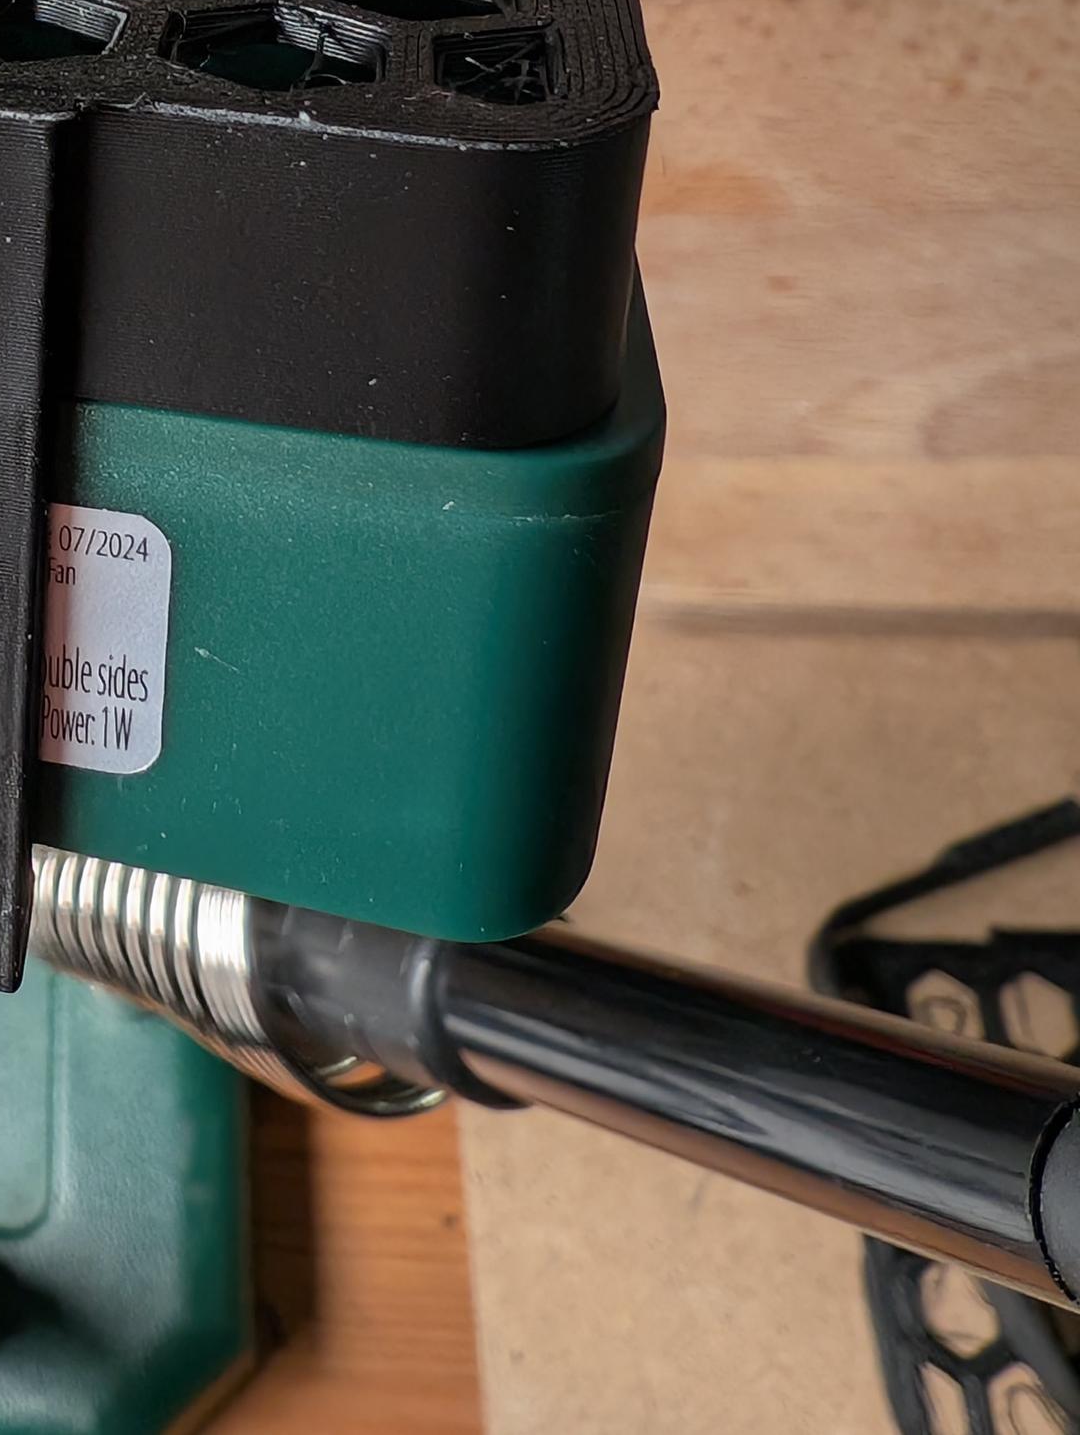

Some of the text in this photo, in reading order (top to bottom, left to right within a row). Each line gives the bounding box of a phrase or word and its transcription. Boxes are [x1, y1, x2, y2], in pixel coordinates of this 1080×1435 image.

[58, 524, 149, 562] 07/2024
[47, 557, 76, 585] Fan
[97, 654, 148, 702] sides
